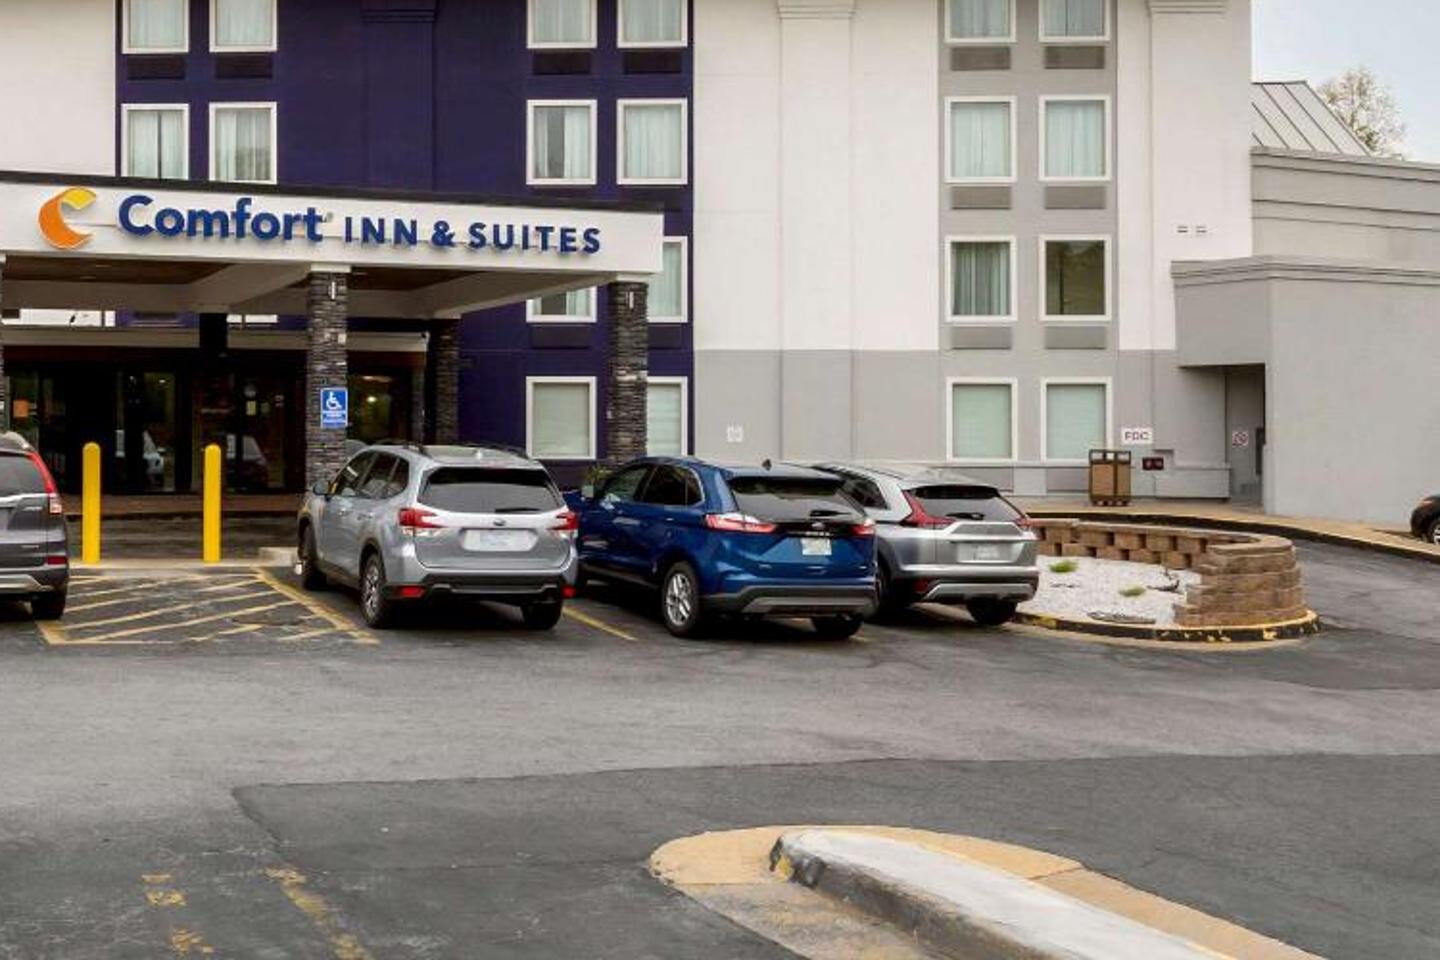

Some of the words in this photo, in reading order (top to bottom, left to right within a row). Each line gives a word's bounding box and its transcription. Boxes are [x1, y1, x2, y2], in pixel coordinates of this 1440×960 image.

[118, 194, 323, 242] Comfort
[344, 216, 417, 245] INN
[431, 220, 456, 248] &
[467, 222, 601, 254] SUITES
[1124, 431, 1150, 441] FDC
